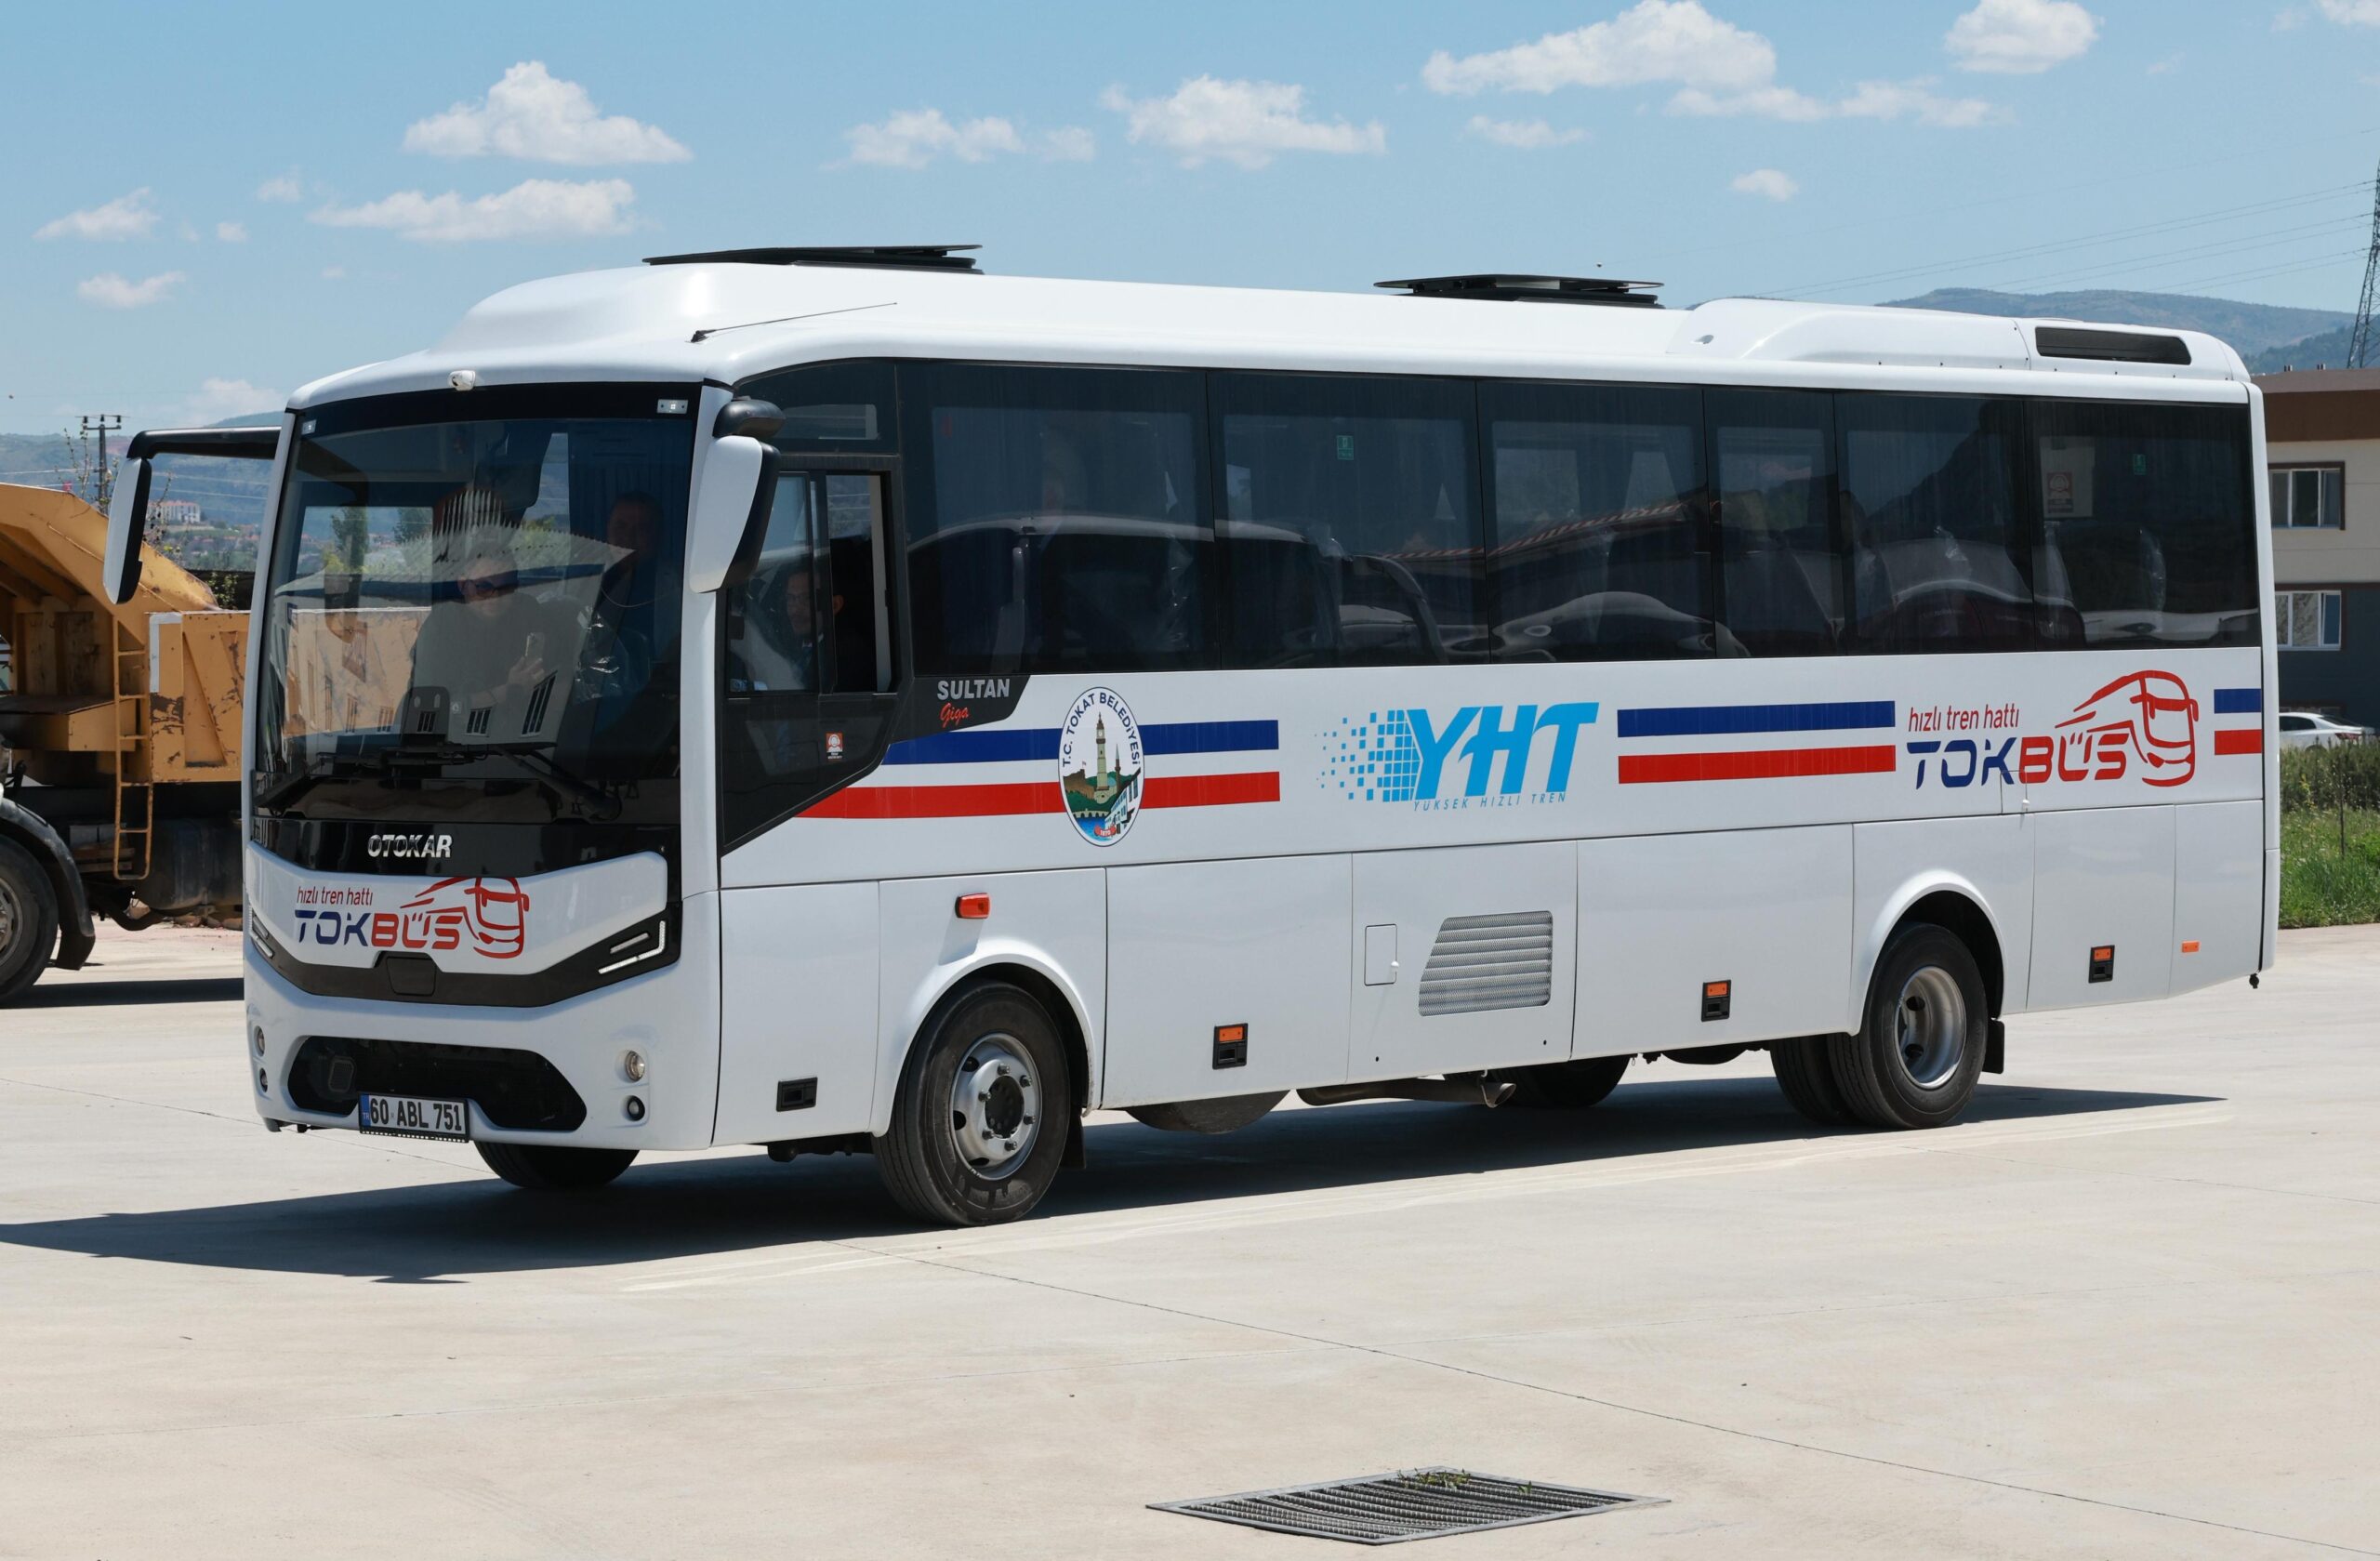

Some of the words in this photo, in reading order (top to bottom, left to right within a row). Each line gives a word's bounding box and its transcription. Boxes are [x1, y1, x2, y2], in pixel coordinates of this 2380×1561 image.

[937, 679, 1011, 700] SULTAN
[939, 702, 970, 729] Giga
[1066, 693, 1096, 735] TOKAT
[1946, 705, 1979, 731] tren
[1063, 741, 1073, 767] T.C.
[1407, 702, 1599, 800] YHT
[1906, 732, 2130, 790] TOKBÜS
[1480, 795, 1521, 807] HIZLI
[1531, 792, 1567, 804] TREN
[367, 834, 453, 858] OTOKAR
[321, 886, 344, 906] tren
[294, 909, 463, 950] TOKBÜS
[370, 1097, 390, 1125] 60
[396, 1100, 430, 1129] ABL
[432, 1103, 462, 1131] 751
